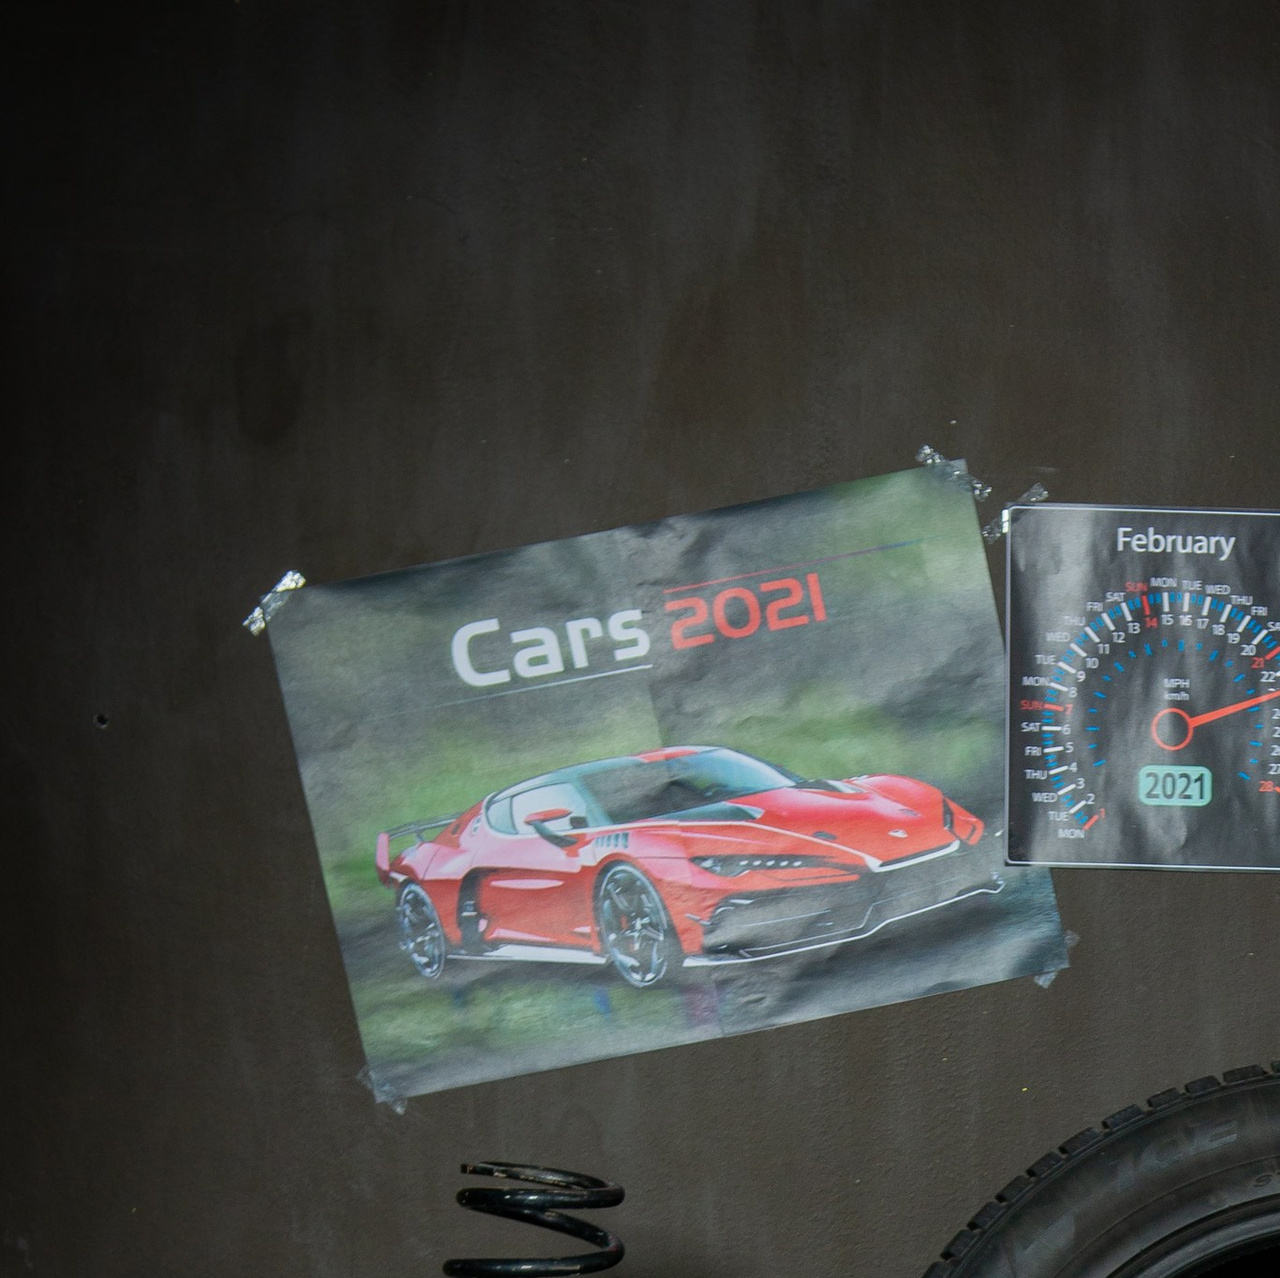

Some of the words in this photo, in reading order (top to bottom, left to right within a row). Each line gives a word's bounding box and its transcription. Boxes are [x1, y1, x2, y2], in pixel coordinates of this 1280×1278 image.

[1117, 526, 1236, 561] February
[1124, 581, 1148, 592] SUN
[1150, 577, 1178, 588] MON
[1182, 580, 1203, 591] TUE
[1205, 584, 1232, 595] WED
[1105, 592, 1126, 602] SAT
[1229, 595, 1253, 605] THU
[1085, 602, 1104, 612] FRI
[1250, 606, 1268, 616] FRI
[1063, 616, 1086, 626] THU
[1144, 617, 1158, 629] 14
[1161, 614, 1174, 625] 15
[1179, 615, 1193, 626] 16
[1196, 618, 1209, 629] 17
[451, 609, 652, 687] Cars
[664, 572, 828, 650] 2021
[1126, 623, 1141, 634] 13
[1212, 625, 1225, 635] 18
[1046, 632, 1071, 642] WED
[1112, 633, 1126, 643] 12
[1227, 633, 1240, 644] 19
[1097, 644, 1110, 654] 11
[1240, 644, 1257, 656] 20
[1035, 655, 1057, 665] TUE
[1085, 658, 1099, 669] 10
[1251, 657, 1265, 669] 21
[1022, 676, 1050, 686] MON
[1076, 671, 1086, 682] 9
[1260, 671, 1276, 682] 22
[1164, 678, 1190, 688] MPH
[1068, 687, 1078, 698] 8
[1020, 700, 1044, 710] SUN
[1065, 703, 1074, 714] 7
[1021, 722, 1042, 732] SAT
[1061, 724, 1071, 735] 6
[1024, 746, 1042, 756] FRI
[1064, 742, 1074, 753] 5
[1068, 762, 1078, 773] 4
[1024, 769, 1048, 780] THU
[1076, 778, 1085, 789] 3
[1145, 772, 1205, 800] 2021
[1259, 781, 1274, 792] 28
[1032, 792, 1058, 802] WED
[1086, 793, 1095, 804] 2
[1048, 811, 1069, 821] TUE
[1057, 829, 1085, 839] MON
